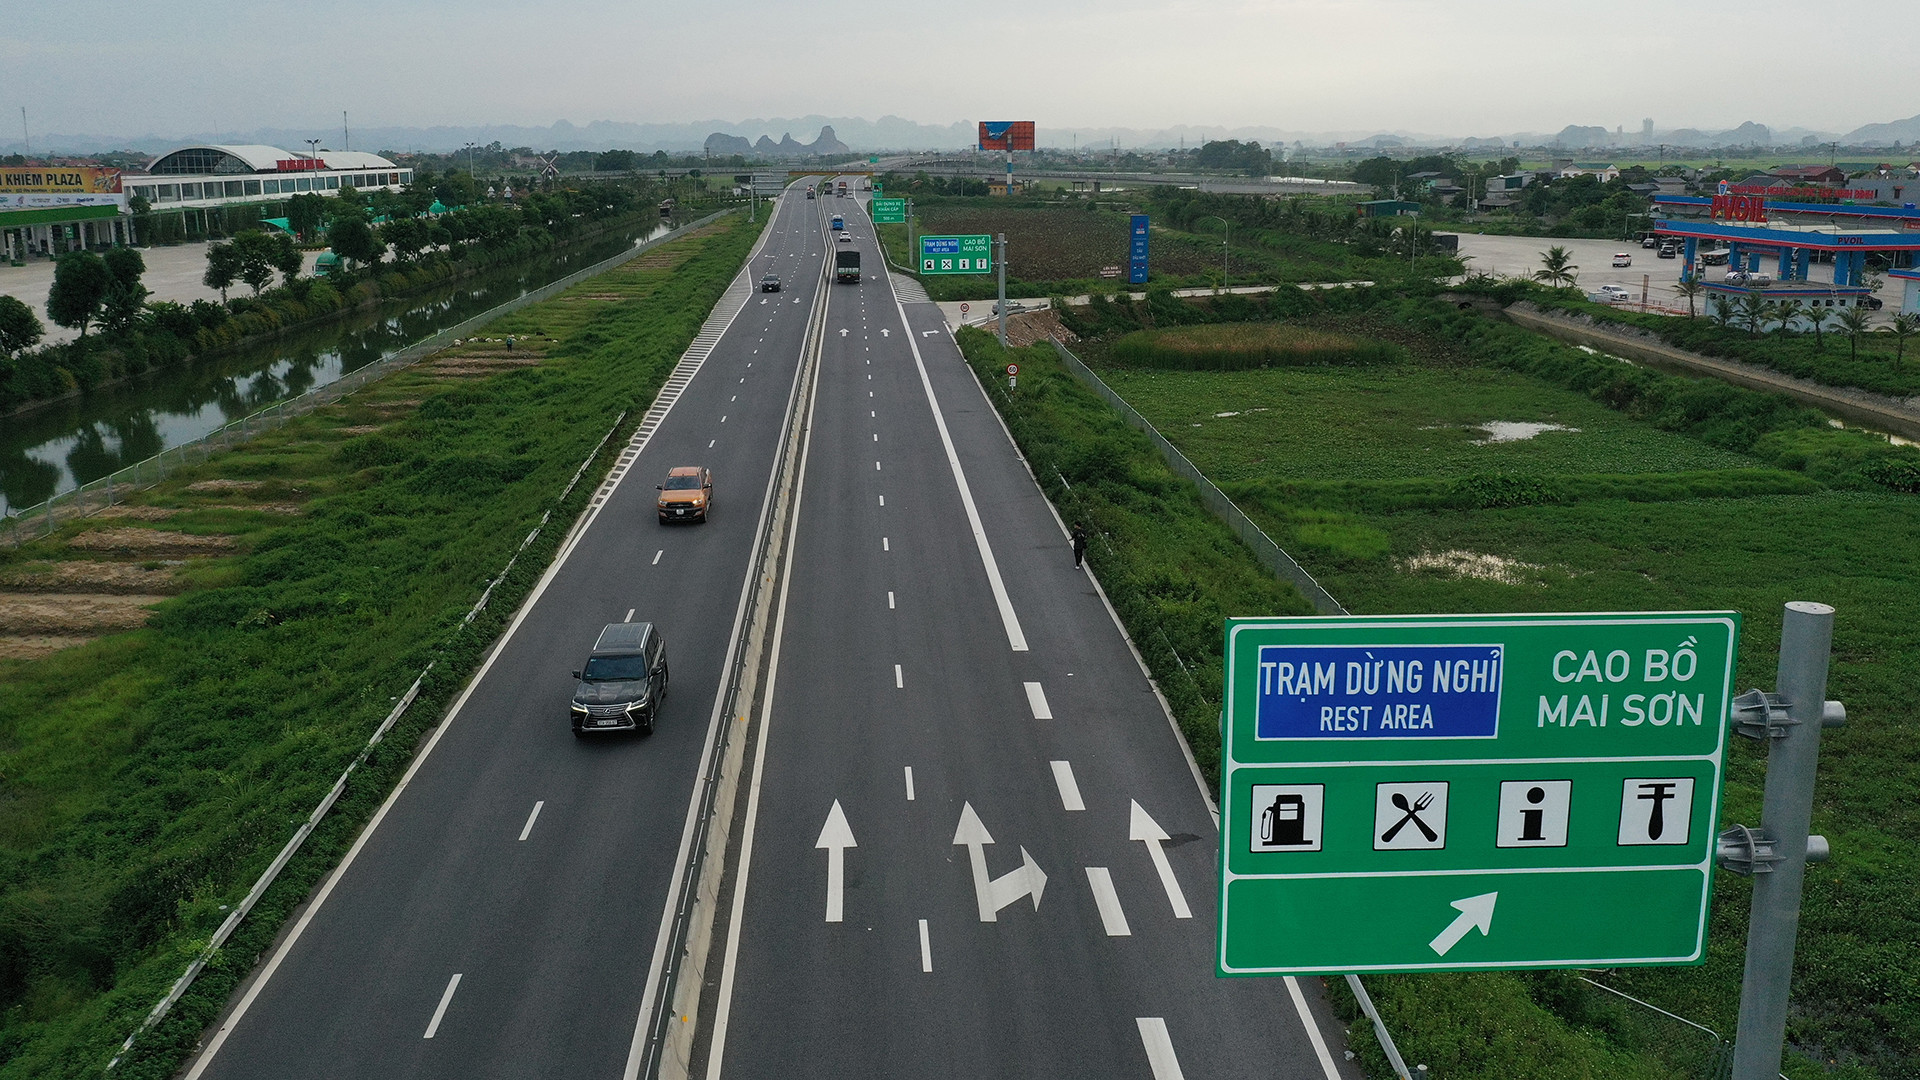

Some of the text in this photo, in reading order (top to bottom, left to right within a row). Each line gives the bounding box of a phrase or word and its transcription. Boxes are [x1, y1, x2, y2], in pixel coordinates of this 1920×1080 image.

[6, 171, 83, 186] KHIÊM PLAZA
[1711, 195, 1768, 222] PVOIL
[1552, 635, 1698, 683] CAO BỒ
[1261, 650, 1500, 702] TRẠM DỪNG NGHỈ
[1320, 704, 1434, 731] REST AREA
[1537, 690, 1705, 727] MAI SƠN
